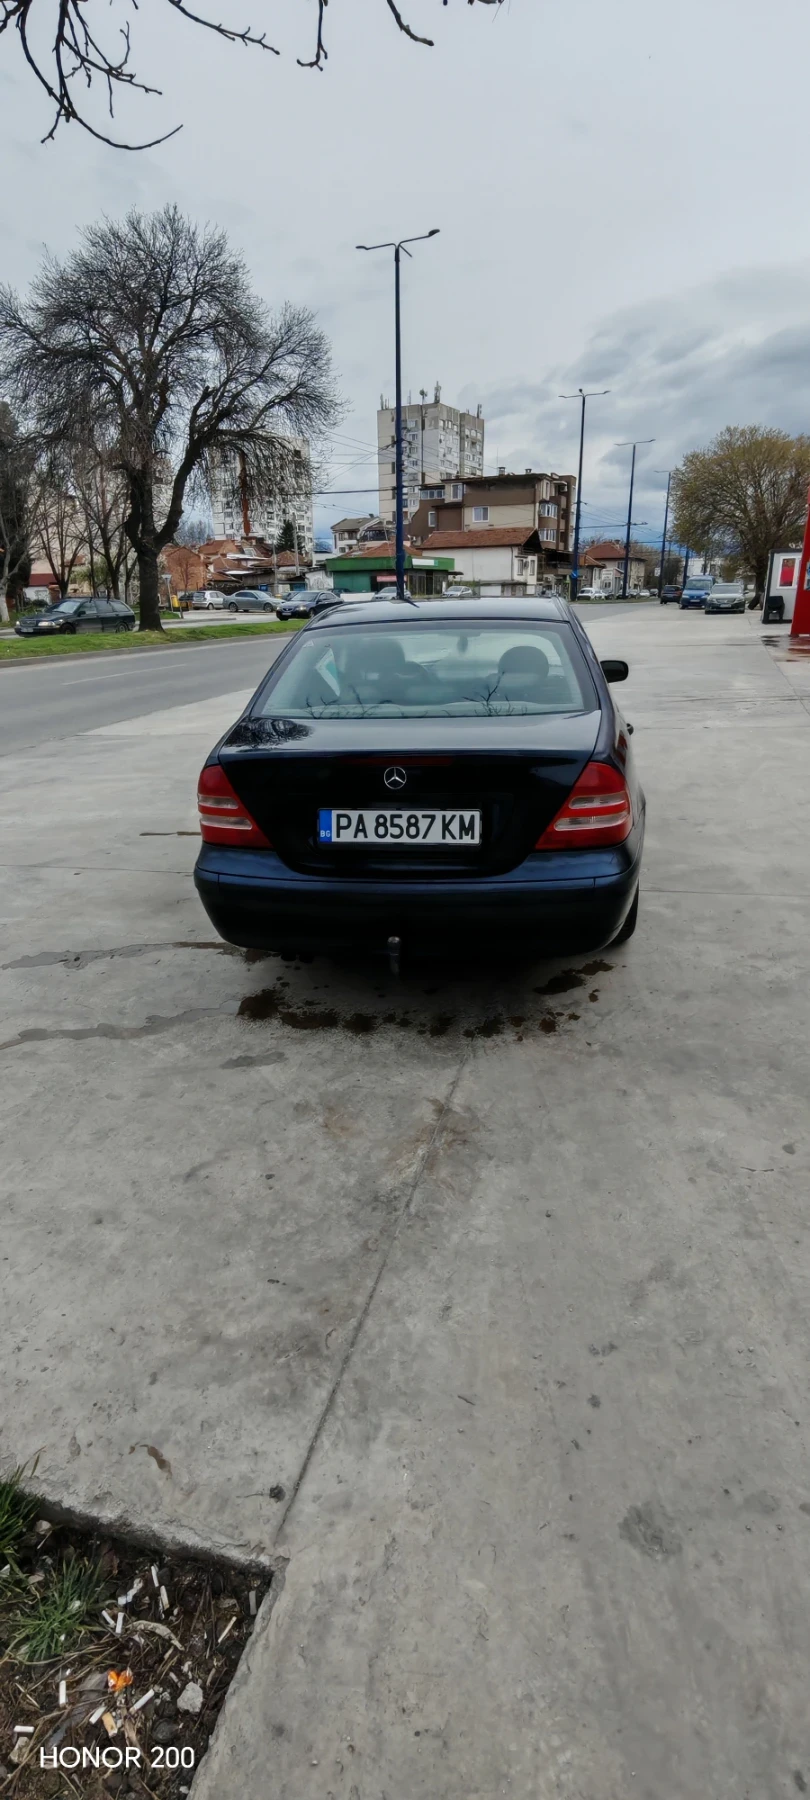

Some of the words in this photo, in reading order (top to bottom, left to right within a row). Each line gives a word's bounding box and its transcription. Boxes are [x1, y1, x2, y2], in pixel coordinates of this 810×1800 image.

[320, 830, 331, 838] BG
[335, 813, 369, 839] PA
[373, 813, 436, 840] 8587
[441, 814, 475, 840] KM
